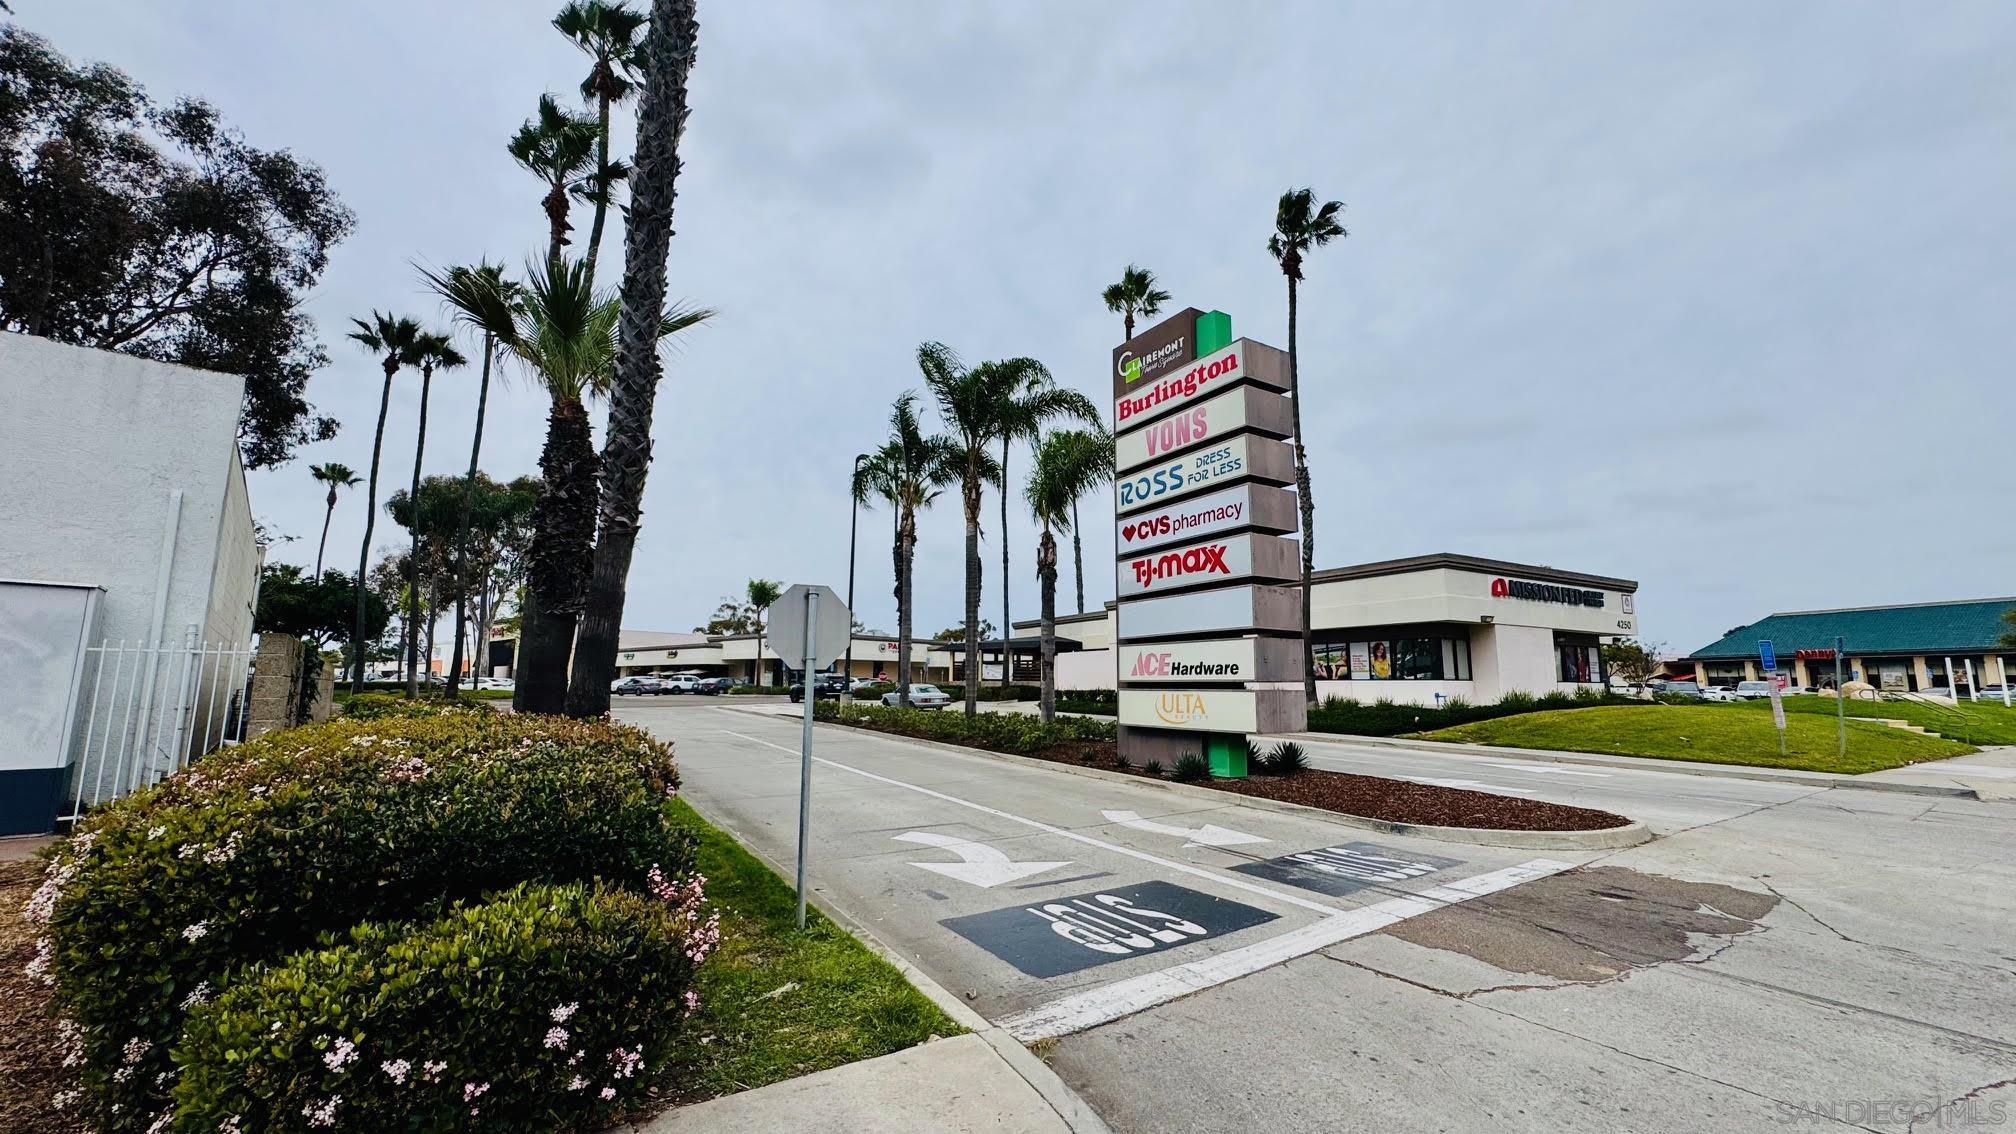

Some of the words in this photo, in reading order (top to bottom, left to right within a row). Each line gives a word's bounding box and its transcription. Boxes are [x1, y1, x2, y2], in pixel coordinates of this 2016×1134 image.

[1117, 336, 1185, 377] CLAIREMONT
[1118, 351, 1238, 422] Burlington
[1145, 406, 1208, 457] VONS
[1195, 446, 1231, 469] DRESS
[1120, 463, 1184, 507] ROSS
[1187, 469, 1209, 486] FOR
[1213, 458, 1242, 476] LESS
[1137, 514, 1171, 540] CVS
[1172, 501, 1243, 536] pharmacy
[1508, 579, 1563, 605] MISSION
[1616, 620, 1632, 630] 4250
[1131, 650, 1172, 677] ACE
[1171, 660, 1239, 677] Hardware
[1161, 692, 1206, 715] ULTA
